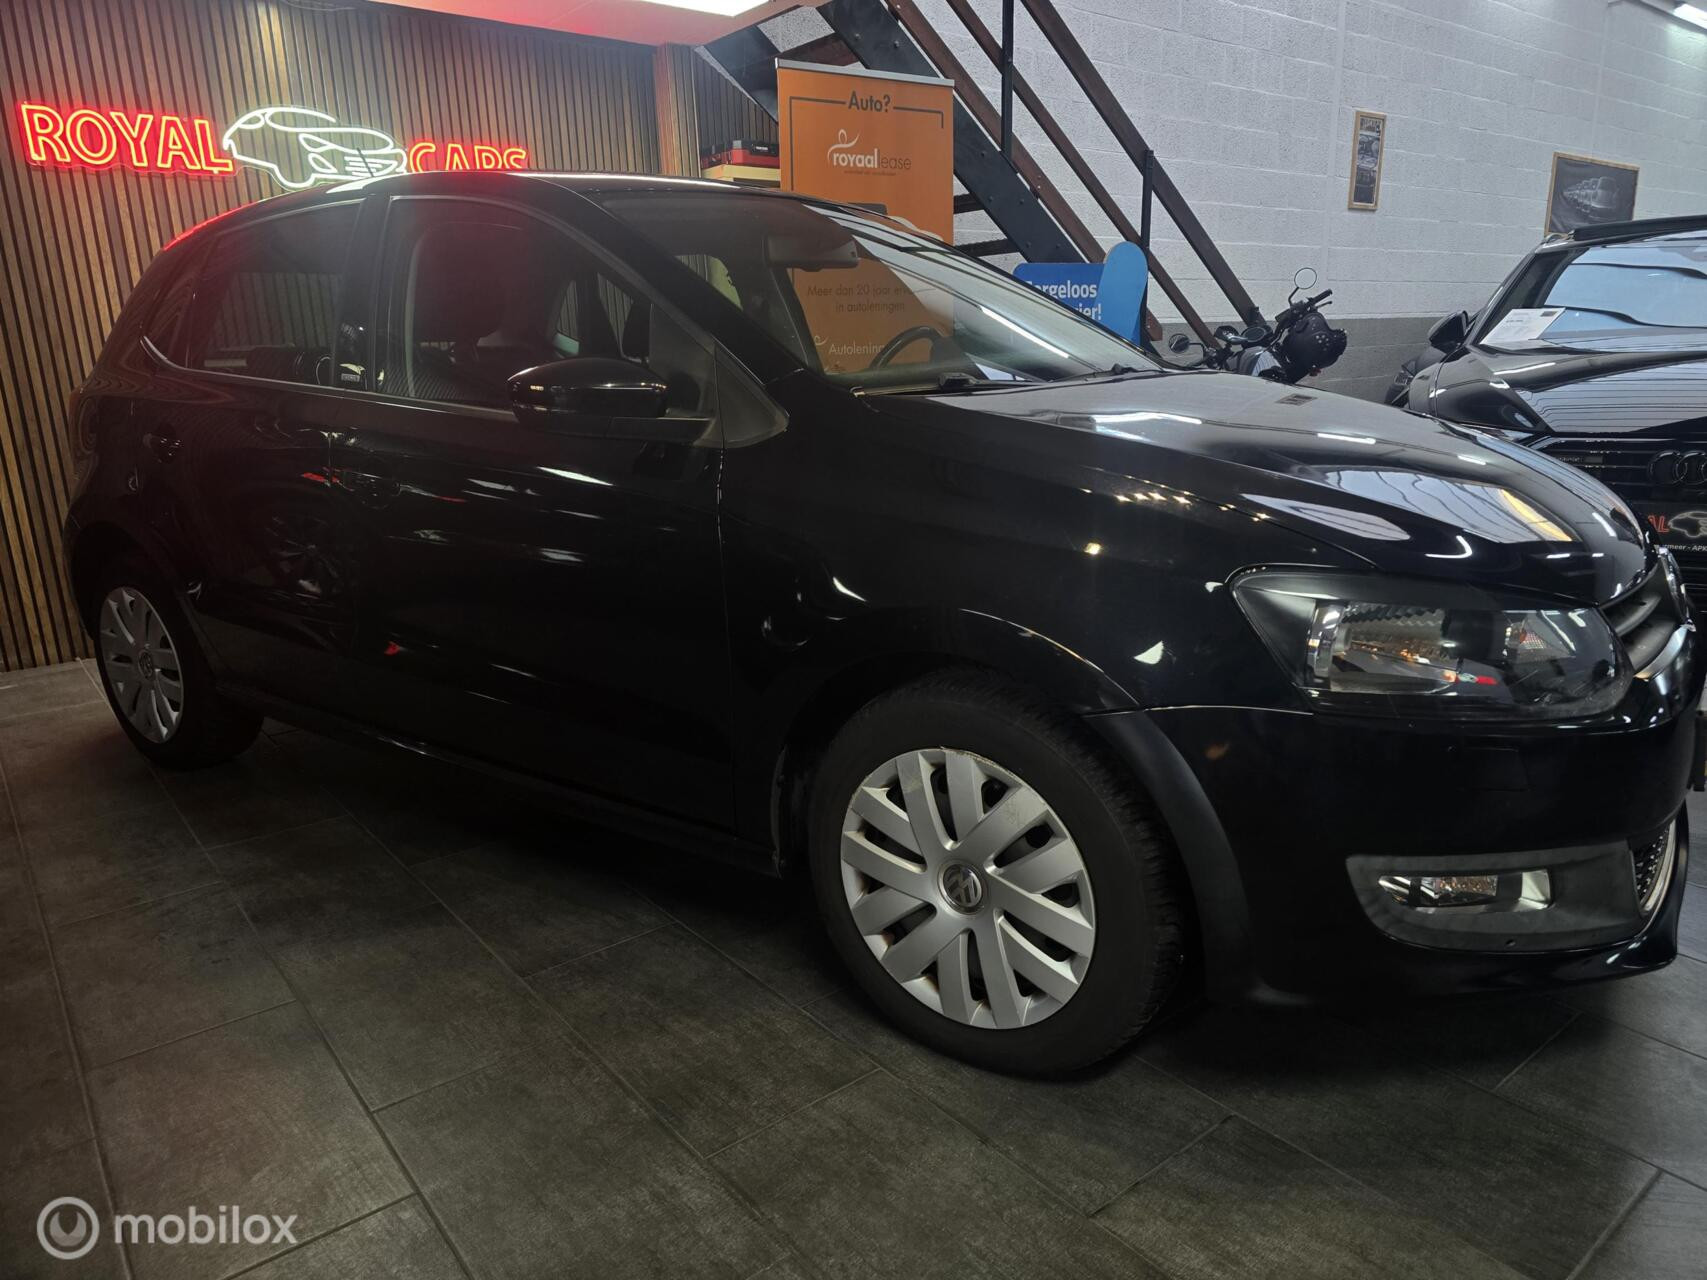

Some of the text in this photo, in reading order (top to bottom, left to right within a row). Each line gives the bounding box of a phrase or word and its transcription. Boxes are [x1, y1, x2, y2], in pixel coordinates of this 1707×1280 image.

[848, 90, 891, 113] Auto?
[21, 102, 234, 174] ROYAL
[807, 285, 833, 297] Meer
[836, 284, 854, 297] dan
[856, 284, 870, 296] 20
[872, 287, 890, 298] jaar
[835, 303, 844, 313] in
